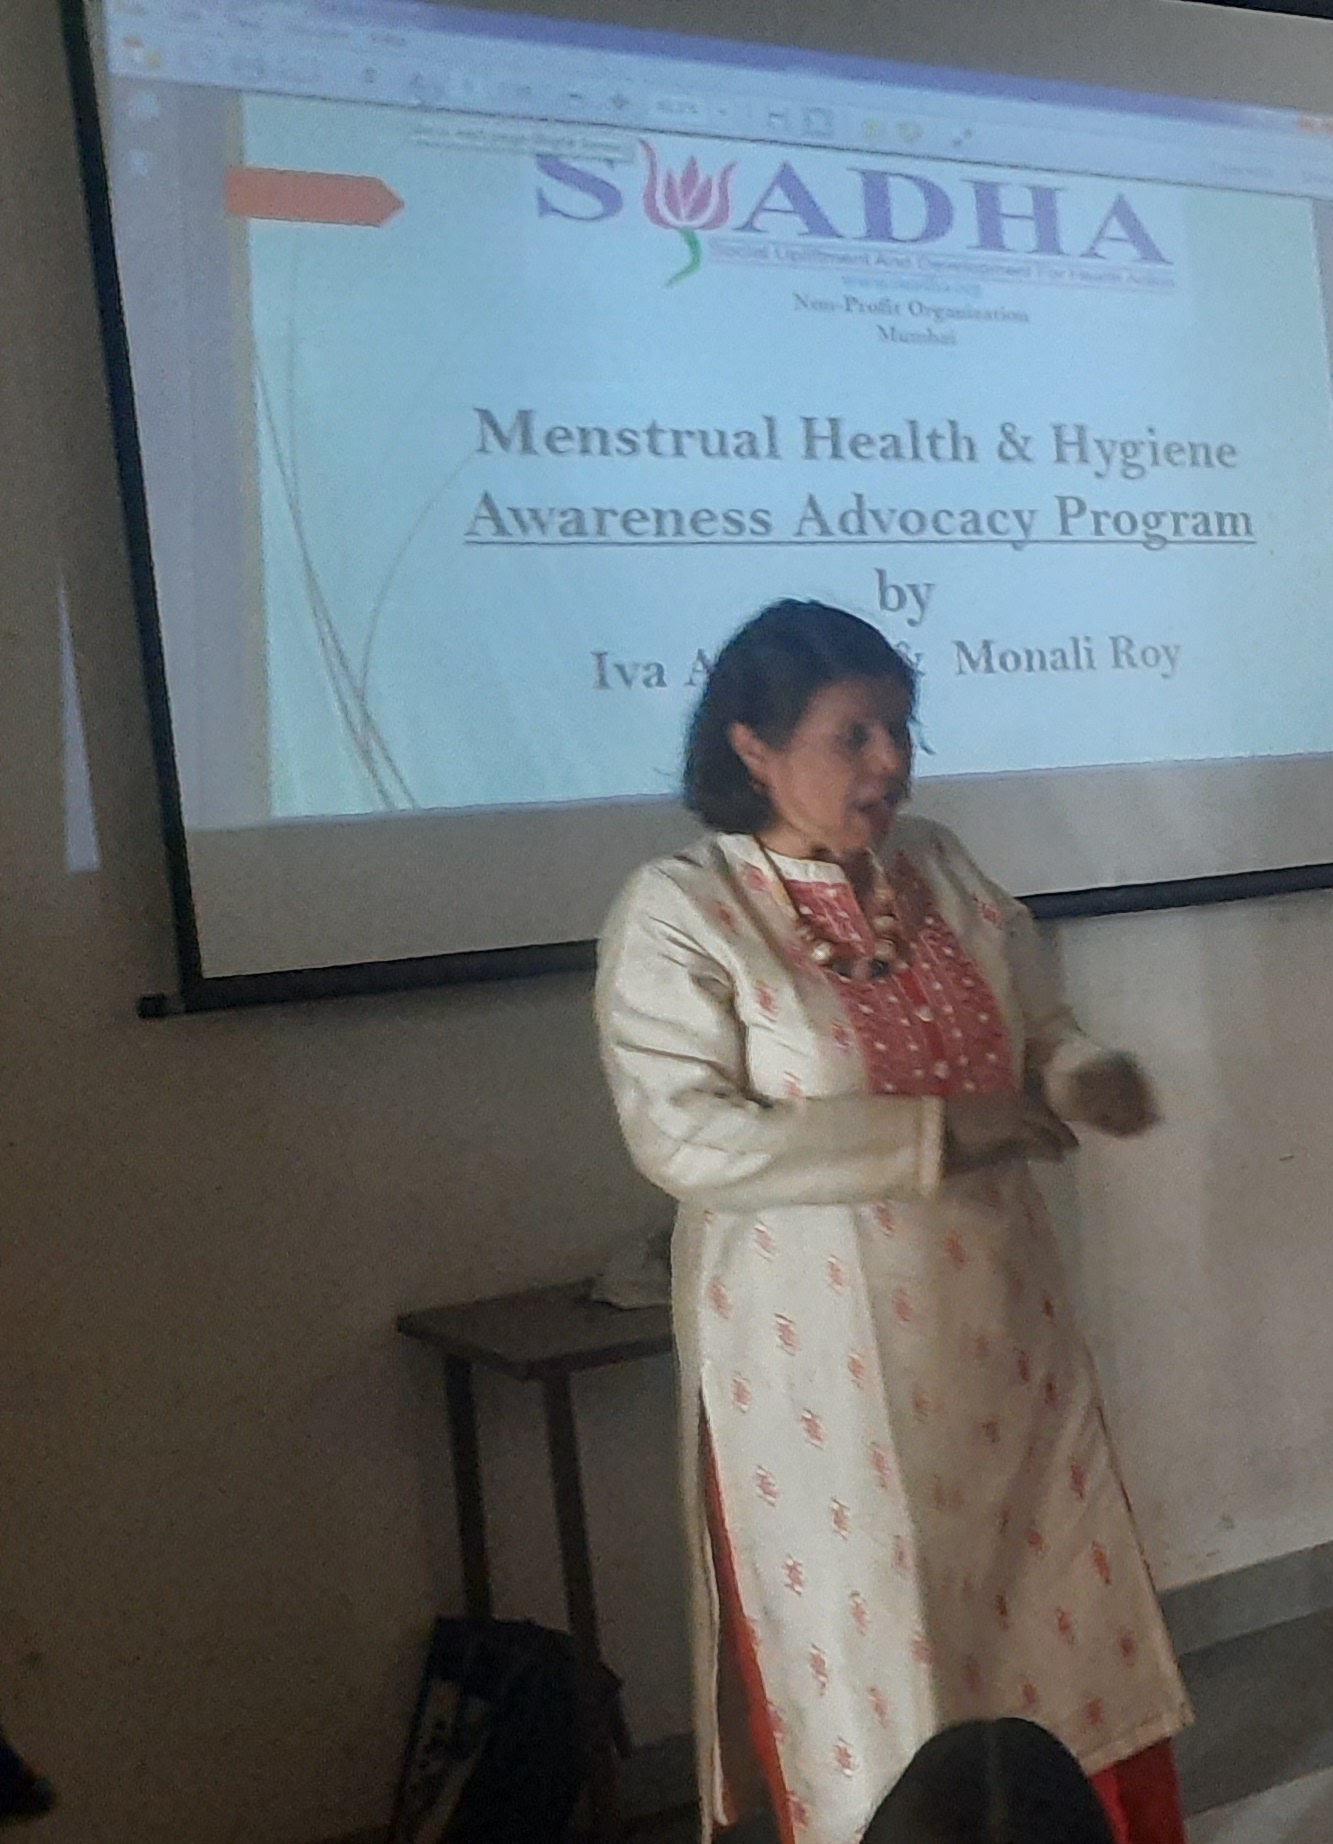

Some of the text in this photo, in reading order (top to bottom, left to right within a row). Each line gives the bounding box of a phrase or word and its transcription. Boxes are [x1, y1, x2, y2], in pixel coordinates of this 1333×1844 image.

[793, 292, 900, 315] Non-Profit
[876, 324, 957, 346] Mumbai
[473, 407, 1239, 480] Menstrual Health & Hygiene
[464, 490, 1255, 551] Awareness Advocacy Program
[874, 566, 936, 627] by
[590, 650, 668, 690] Iva
[952, 636, 1097, 676] Monali
[1109, 634, 1182, 680] Roy
